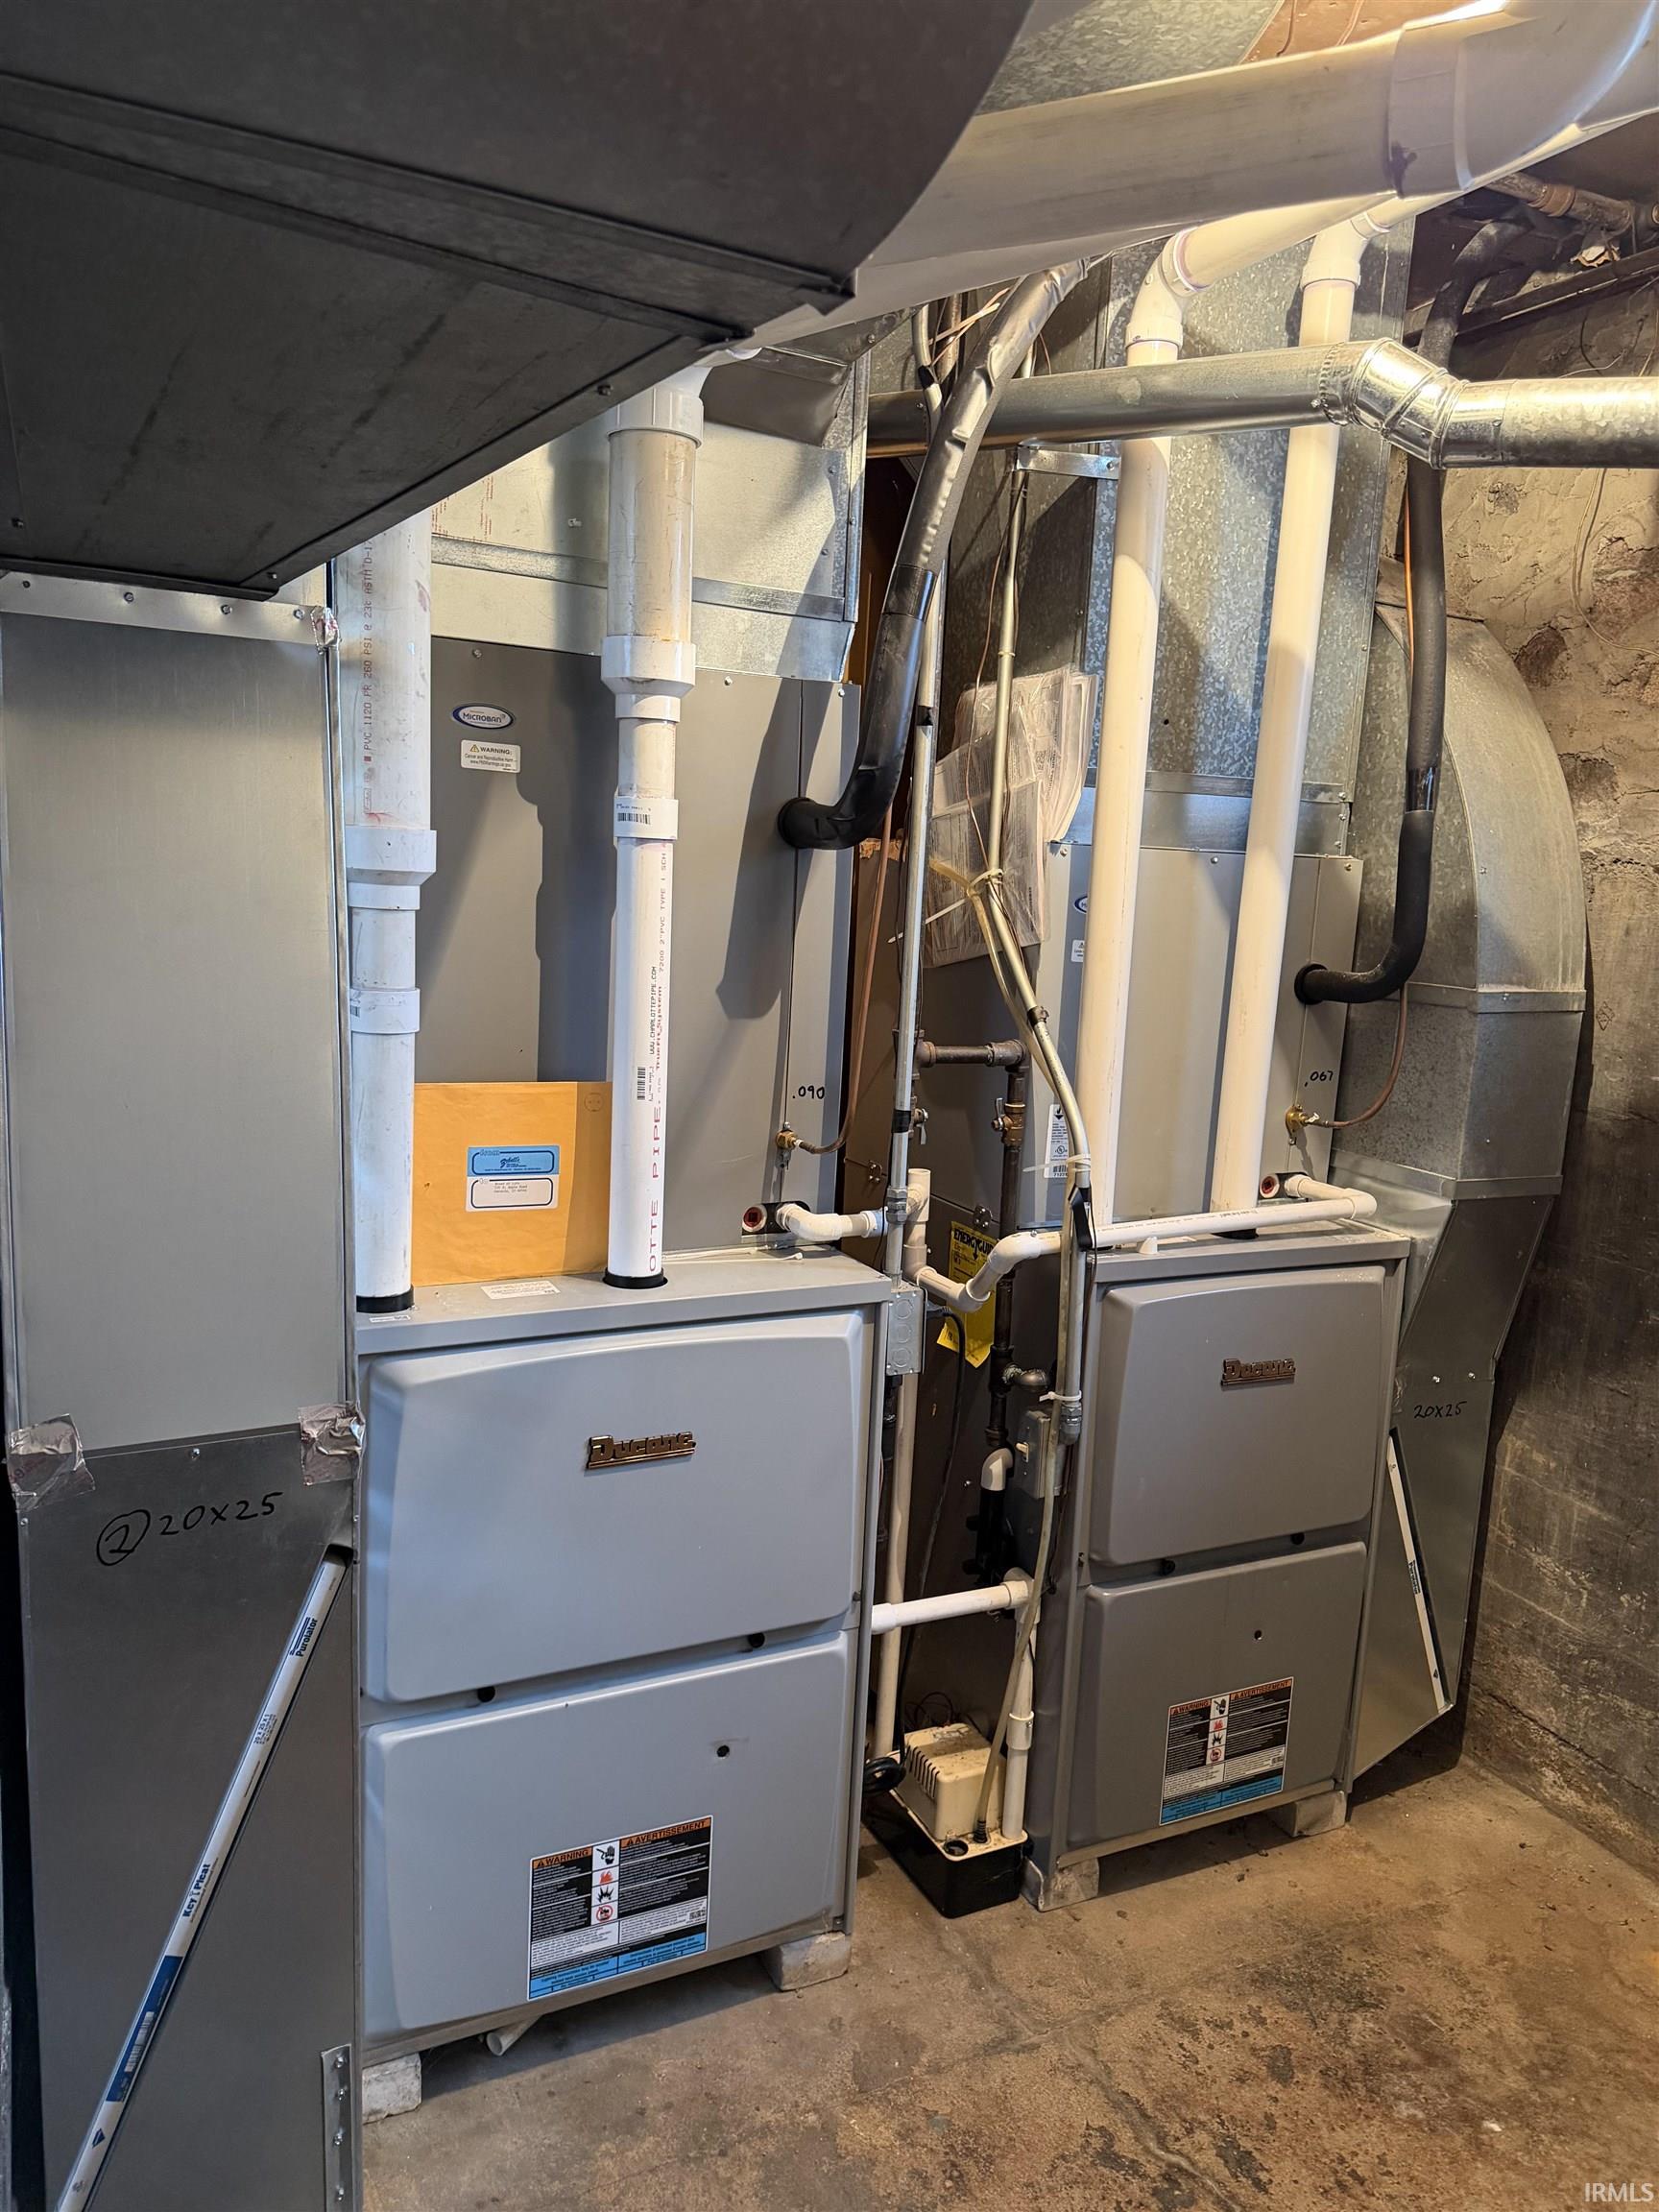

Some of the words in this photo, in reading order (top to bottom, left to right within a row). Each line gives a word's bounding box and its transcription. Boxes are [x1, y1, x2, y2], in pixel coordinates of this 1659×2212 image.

[363, 637, 373, 656] PSI
[363, 685, 373, 697] PR
[363, 702, 373, 726] 1120
[363, 732, 373, 751] PVC
[792, 1085, 825, 1099] .090
[649, 1199, 658, 1272] OTTE
[295, 1618, 318, 1657] Purolator
[635, 1821, 707, 1844] AVERTISSEMENT
[545, 1850, 589, 1865] WARNING
